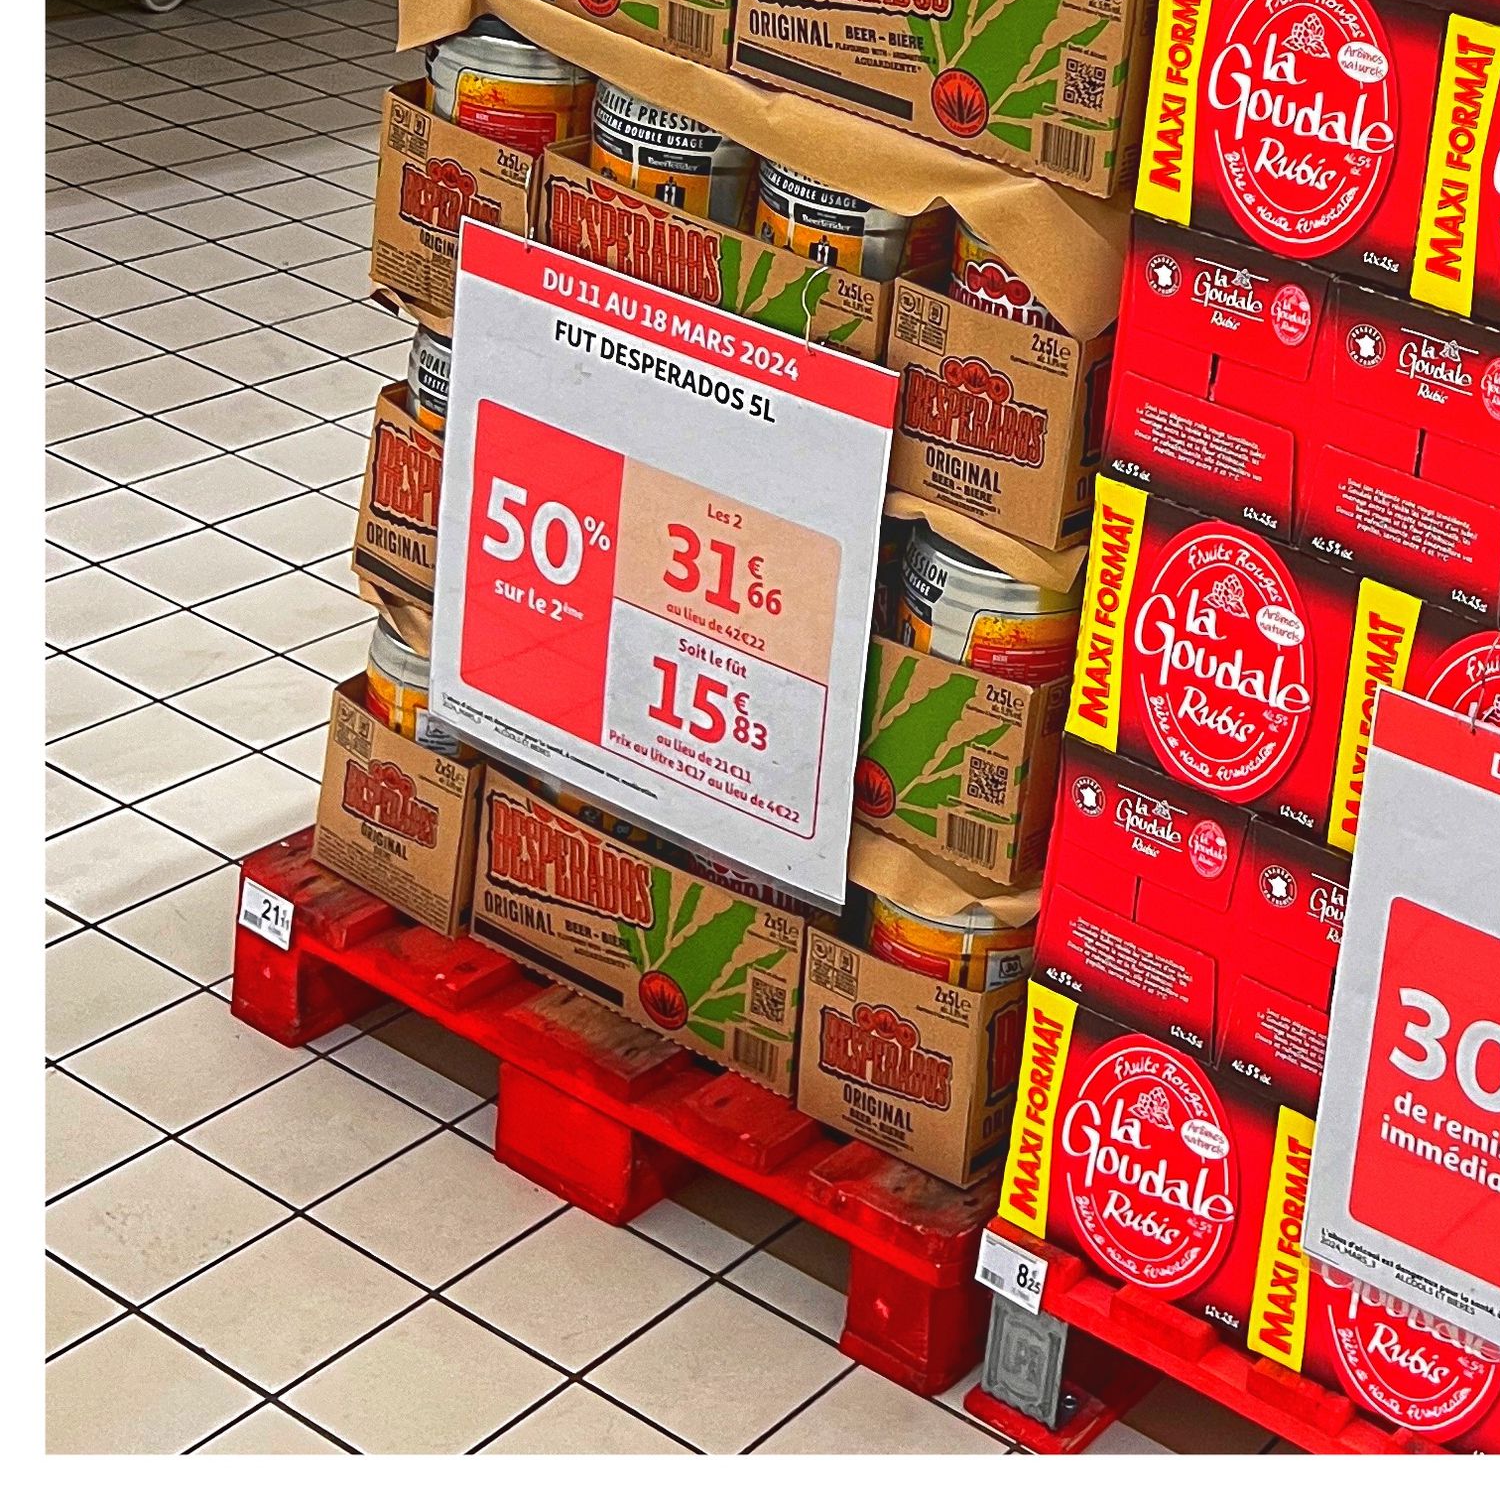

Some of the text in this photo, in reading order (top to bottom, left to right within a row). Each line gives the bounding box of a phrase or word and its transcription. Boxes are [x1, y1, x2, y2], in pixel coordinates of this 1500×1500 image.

[749, 11, 833, 49] ORIGINAL
[543, 267, 799, 383] DU 11 AU 18 MARS 2024
[554, 320, 776, 424] FUT DESPERADOS 5L
[707, 503, 743, 530] Les 2
[494, 579, 524, 603] sur
[528, 588, 547, 615] le
[666, 602, 765, 652] au lieu de 42€22
[679, 638, 747, 680] Soit le fût
[608, 729, 632, 754] Prix
[649, 745, 674, 774] litre
[657, 732, 672, 748] au
[673, 736, 695, 759] lieu
[697, 746, 713, 766] de
[491, 797, 653, 927] DESPERADOS
[482, 896, 555, 936] ORIGINAL
[1010, 1007, 1064, 1219] MAXI FORMAT
[1394, 1091, 1428, 1127] de
